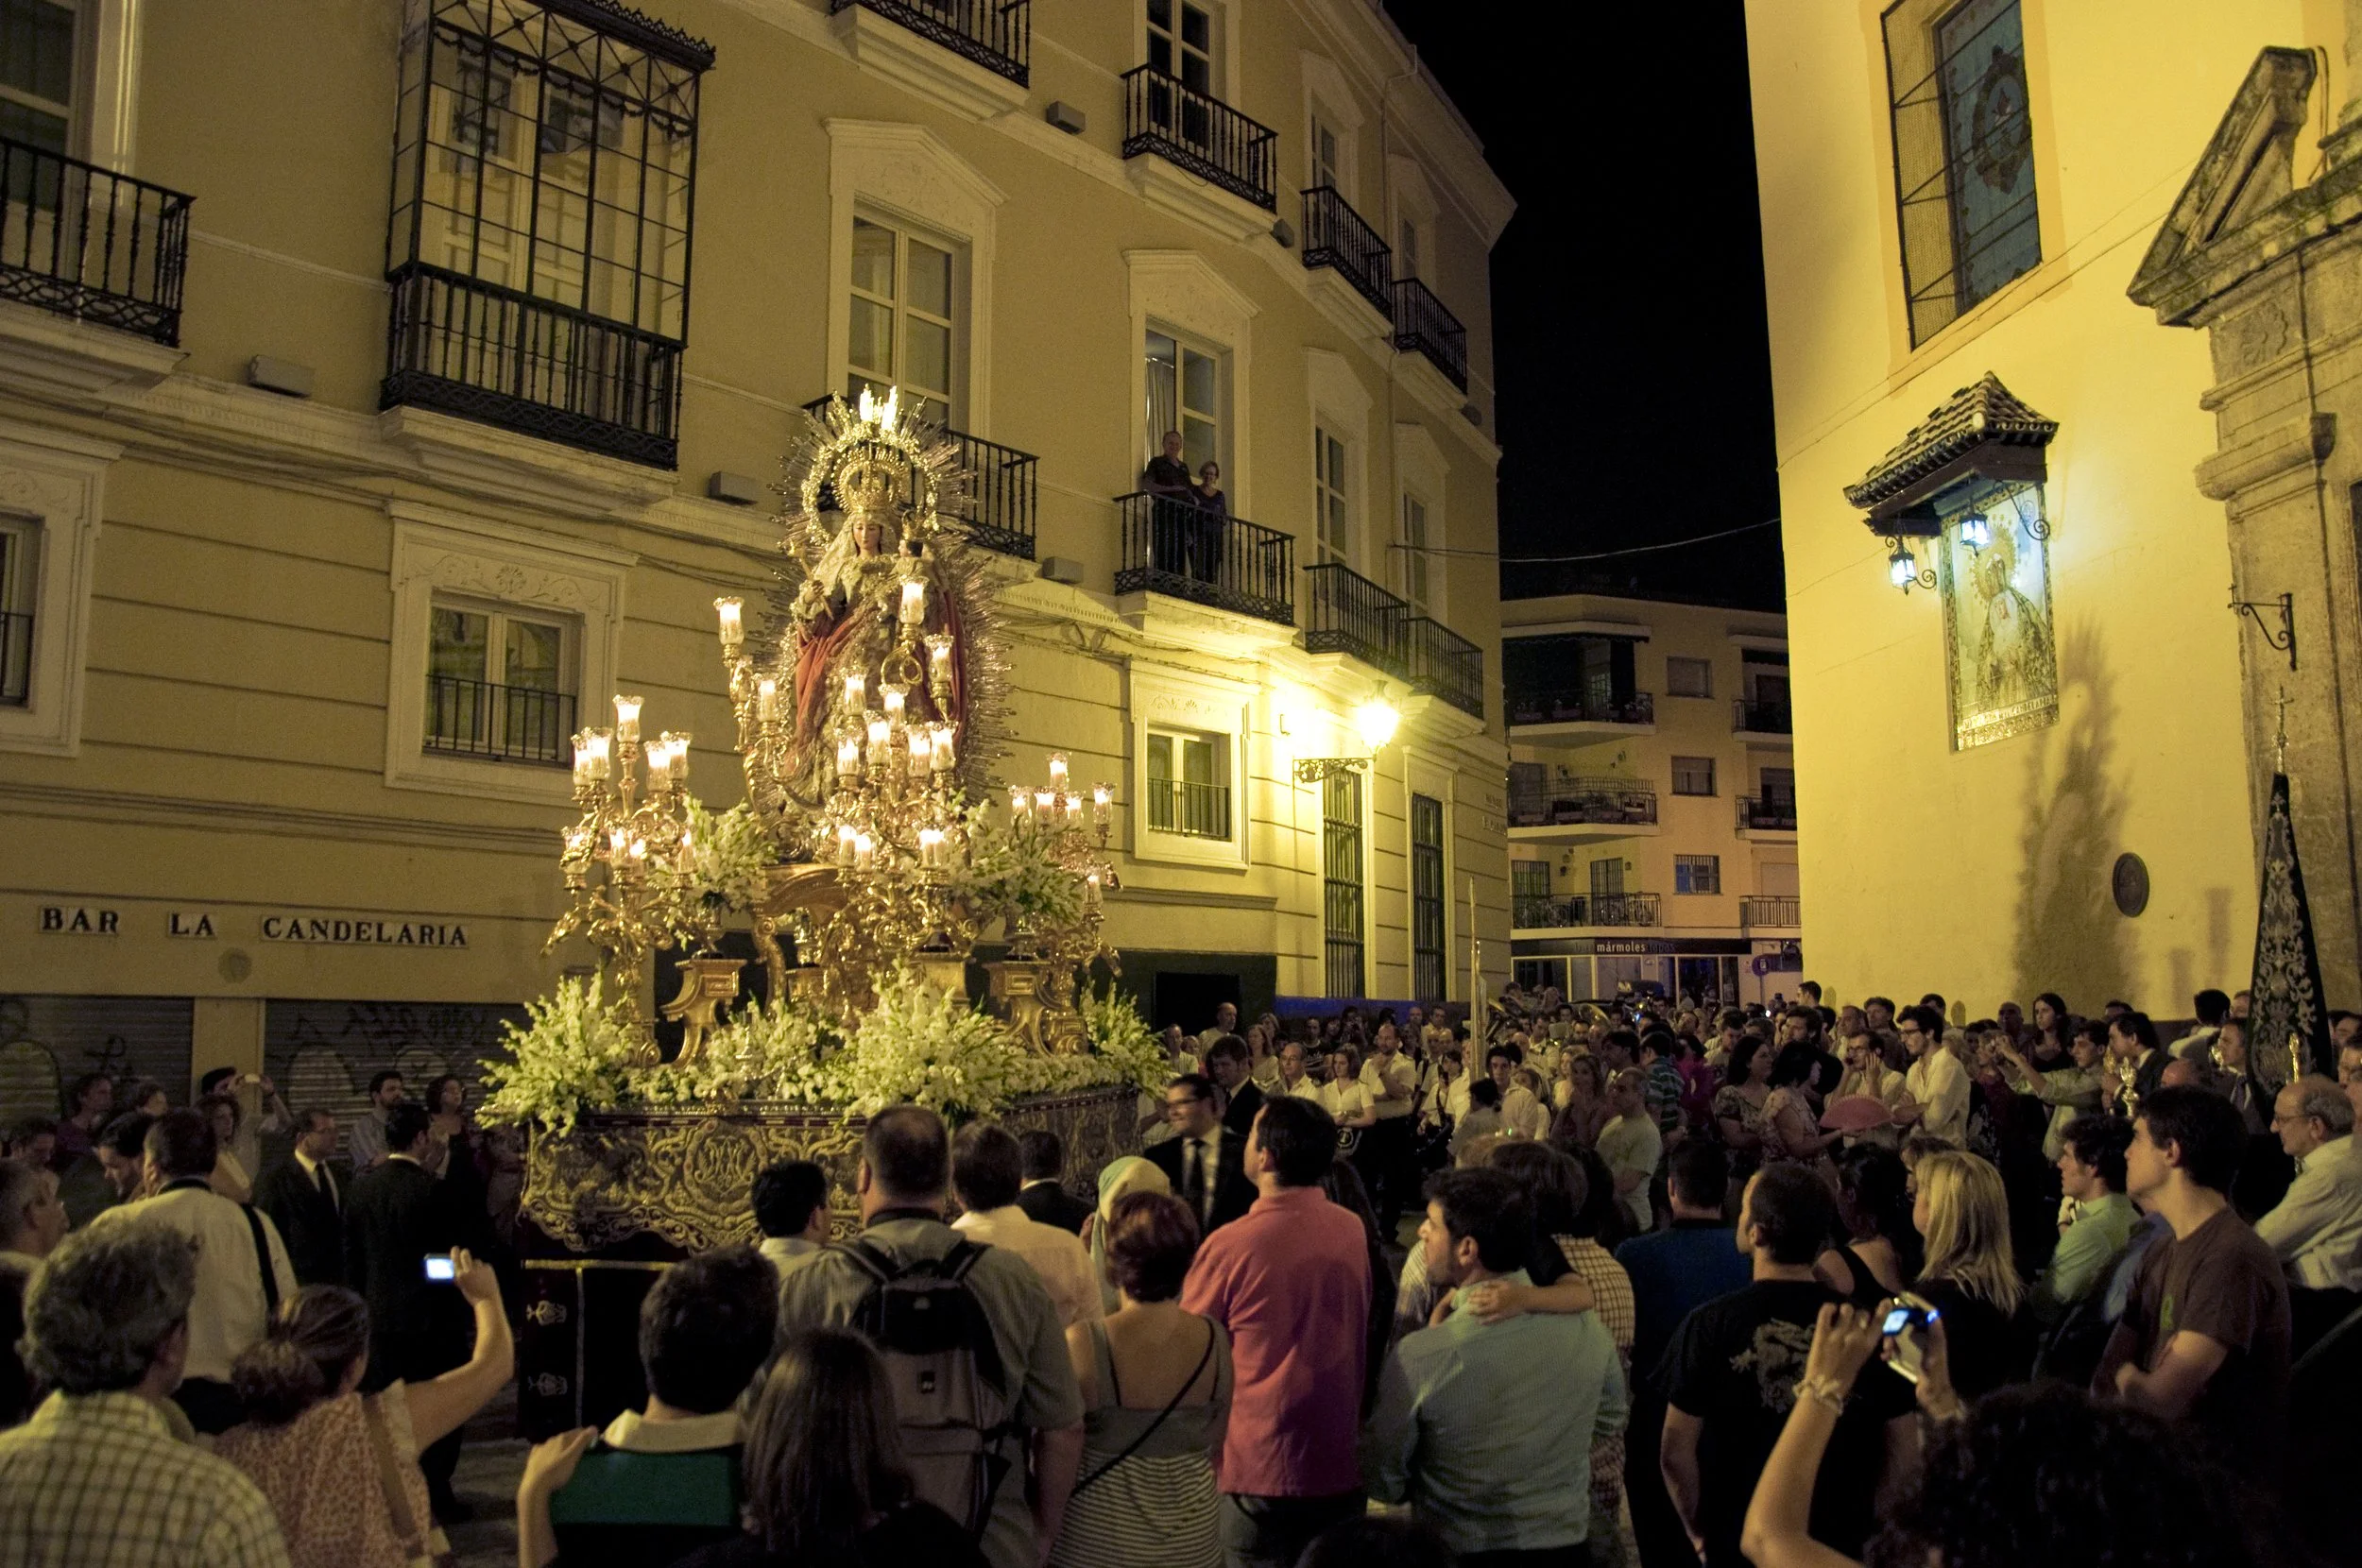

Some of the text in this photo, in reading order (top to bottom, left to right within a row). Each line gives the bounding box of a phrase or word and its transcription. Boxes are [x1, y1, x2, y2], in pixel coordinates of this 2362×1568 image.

[42, 907, 467, 946] BAR LA CANDELARIA
[1597, 941, 1646, 953] mármoles
